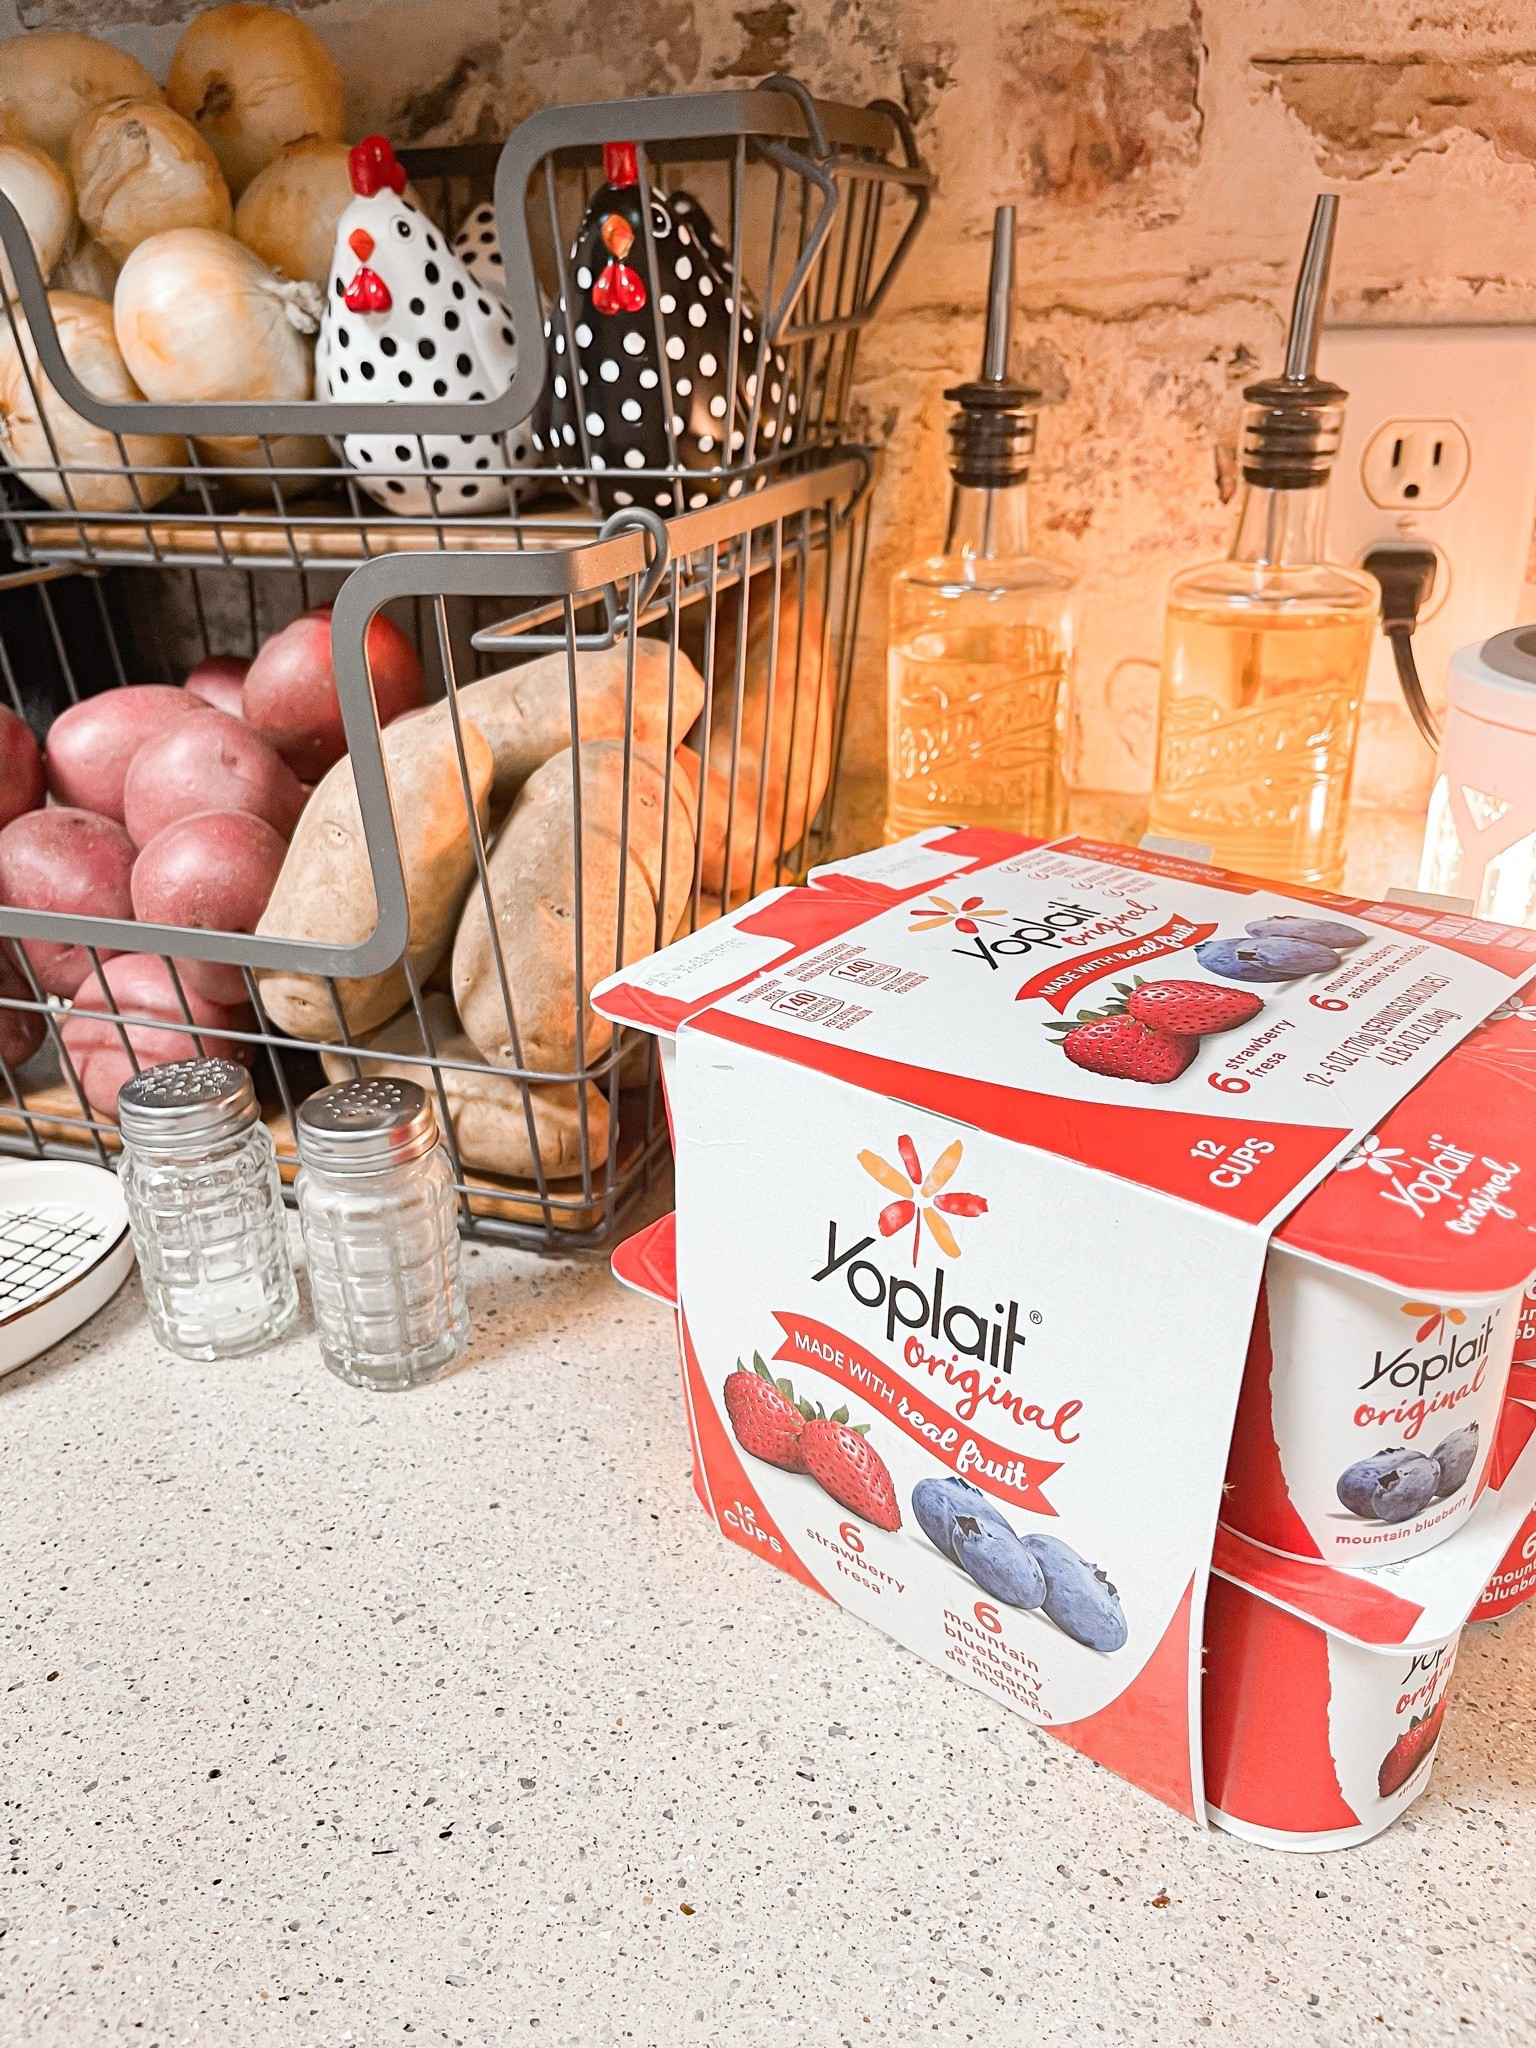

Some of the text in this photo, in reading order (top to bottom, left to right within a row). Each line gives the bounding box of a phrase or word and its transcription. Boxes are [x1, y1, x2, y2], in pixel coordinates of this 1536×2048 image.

[1061, 899, 1158, 947] original
[837, 961, 875, 978] 140
[1039, 923, 1198, 996] MADE WITH real fruit
[1323, 944, 1404, 993] mountain blueberry
[1380, 960, 1401, 973] de
[779, 992, 818, 1011] 140
[1309, 994, 1349, 1012] 6
[1225, 1019, 1296, 1070] strawberry
[1380, 1046, 1413, 1062] LB
[1392, 1040, 1420, 1051] 8
[1398, 1029, 1431, 1046] OZ
[1246, 1051, 1288, 1078] fresa
[1319, 1061, 1347, 1073] 6
[1326, 1050, 1359, 1067] OZ
[1376, 1055, 1403, 1066] 4
[1208, 1072, 1251, 1094] 6
[1303, 1072, 1335, 1088] 12
[1190, 1139, 1226, 1160] 12
[1208, 1137, 1275, 1188] CUPS
[1445, 1156, 1521, 1235] original
[903, 1336, 1083, 1444] original
[1354, 1354, 1489, 1441] original
[794, 1330, 1030, 1491] MADE WITH real fruit
[733, 1501, 757, 1524] 12
[1335, 1494, 1468, 1545] mountain blueberry
[723, 1509, 783, 1553] CUPS
[839, 1521, 865, 1553] 6
[806, 1528, 905, 1593] strawberry
[836, 1560, 881, 1594] fresa
[974, 1602, 1002, 1634] 6
[944, 1609, 1038, 1673] mountain
[944, 1622, 1042, 1691] blueberry
[945, 1650, 1053, 1720] de montaña
[954, 1645, 1038, 1701] arándano
